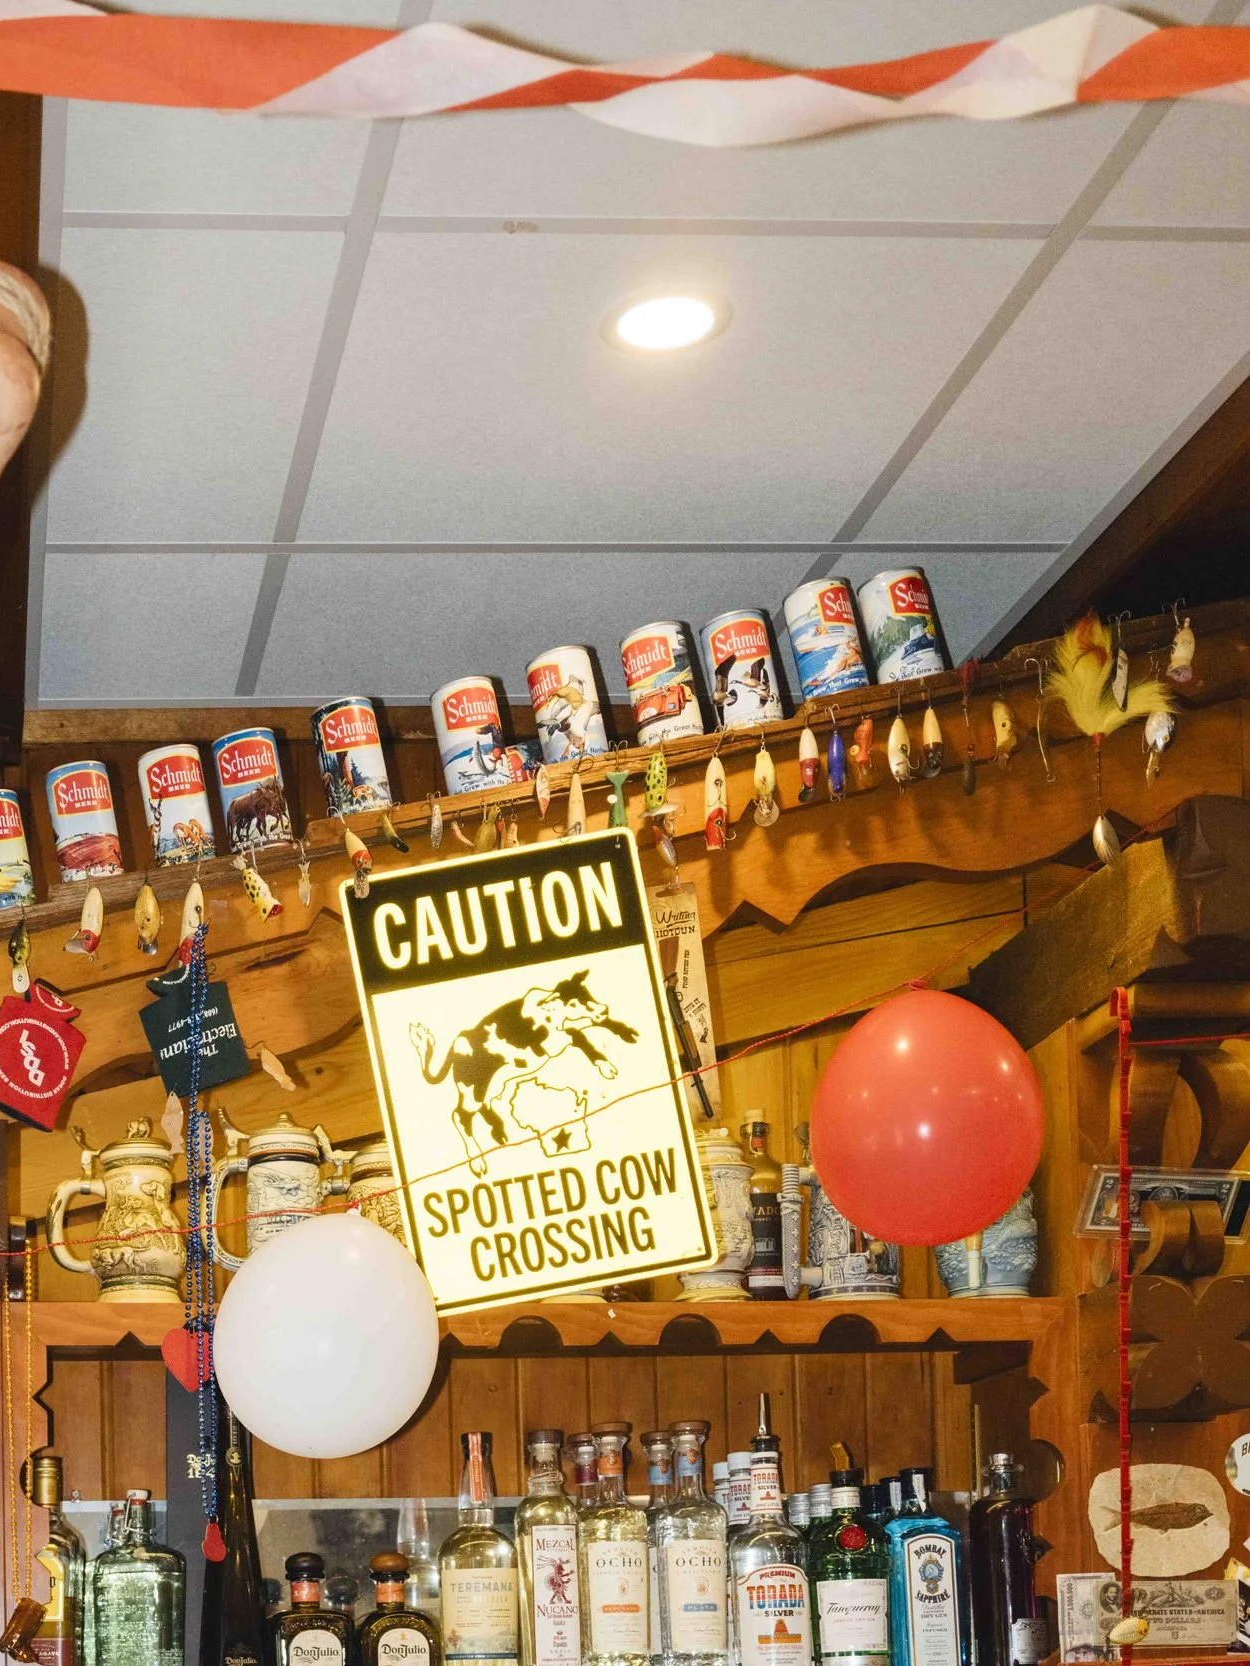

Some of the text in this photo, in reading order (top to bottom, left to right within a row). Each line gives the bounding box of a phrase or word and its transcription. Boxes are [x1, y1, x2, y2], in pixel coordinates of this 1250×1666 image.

[714, 629, 768, 658] Schmidt
[916, 665, 932, 677] Grow
[447, 694, 497, 724] Schmidt
[326, 717, 377, 744] Schmidt
[221, 748, 274, 779] Schmidt
[151, 764, 203, 793] Schmidt
[464, 779, 496, 793] Grow with
[57, 779, 109, 808] Schmidt
[372, 860, 625, 970] CAUTION
[654, 926, 695, 938] HOTGUN
[19, 1029, 45, 1087] DDSI
[9, 1081, 53, 1099] DISTRIBUTION
[422, 1148, 678, 1239] SPOTTED COW
[470, 1206, 657, 1283] CROSSING
[753, 1473, 779, 1483] TORADA
[536, 1538, 575, 1551] MEZCAL
[914, 1544, 947, 1559] BOMBAY
[596, 1558, 642, 1568] OCHO
[676, 1557, 721, 1568] OCHO
[759, 1570, 795, 1580] PREMIUM
[450, 1582, 513, 1593] TEREMANA
[746, 1584, 805, 1609] TORADA
[915, 1589, 950, 1603] SAPPHIRE
[537, 1604, 578, 1617] NUCANO
[764, 1609, 794, 1617] SILVER
[826, 1602, 881, 1615] Tanqueray
